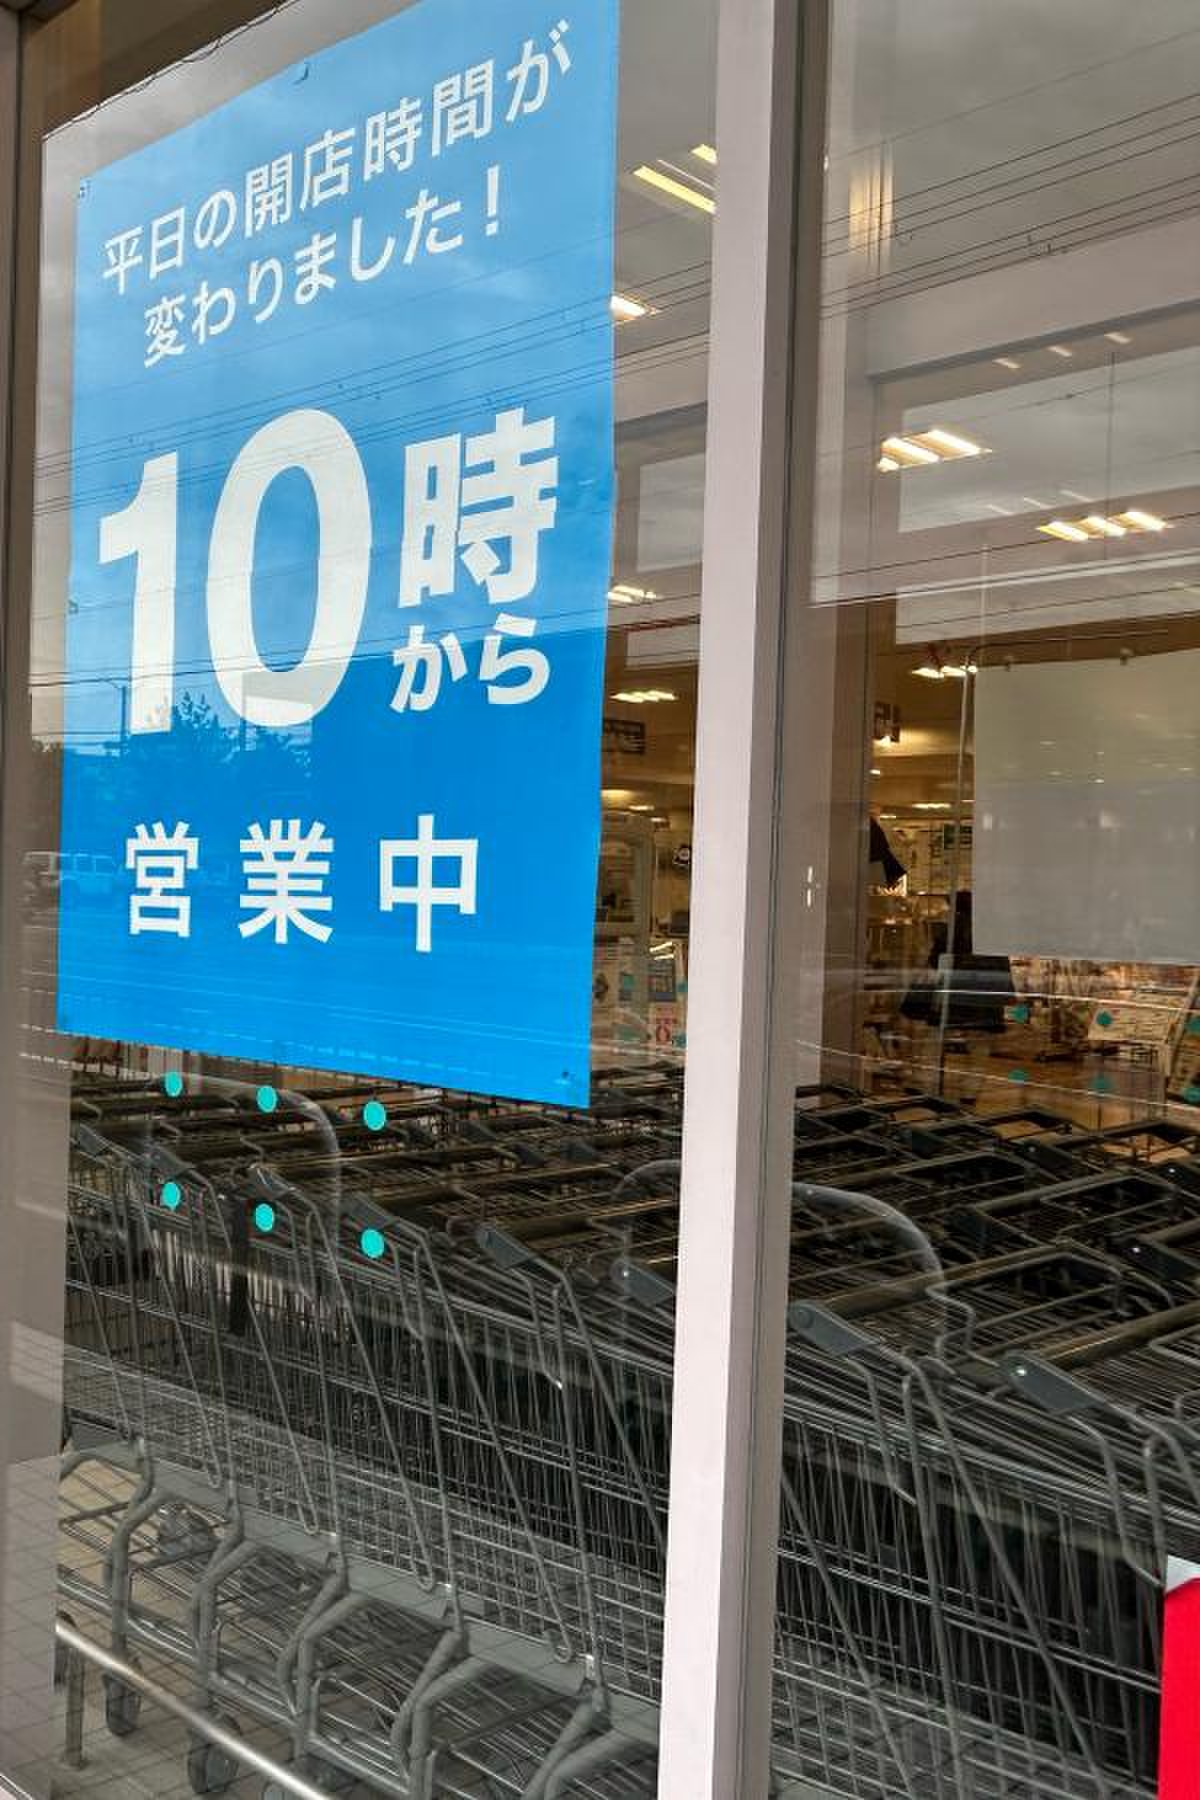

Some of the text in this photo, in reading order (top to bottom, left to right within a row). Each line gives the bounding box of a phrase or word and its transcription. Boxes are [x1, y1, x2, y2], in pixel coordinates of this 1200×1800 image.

[102, 18, 571, 295] 平日の開店時間が
[143, 165, 500, 368] 変わりました！
[124, 813, 480, 953] 営業中
